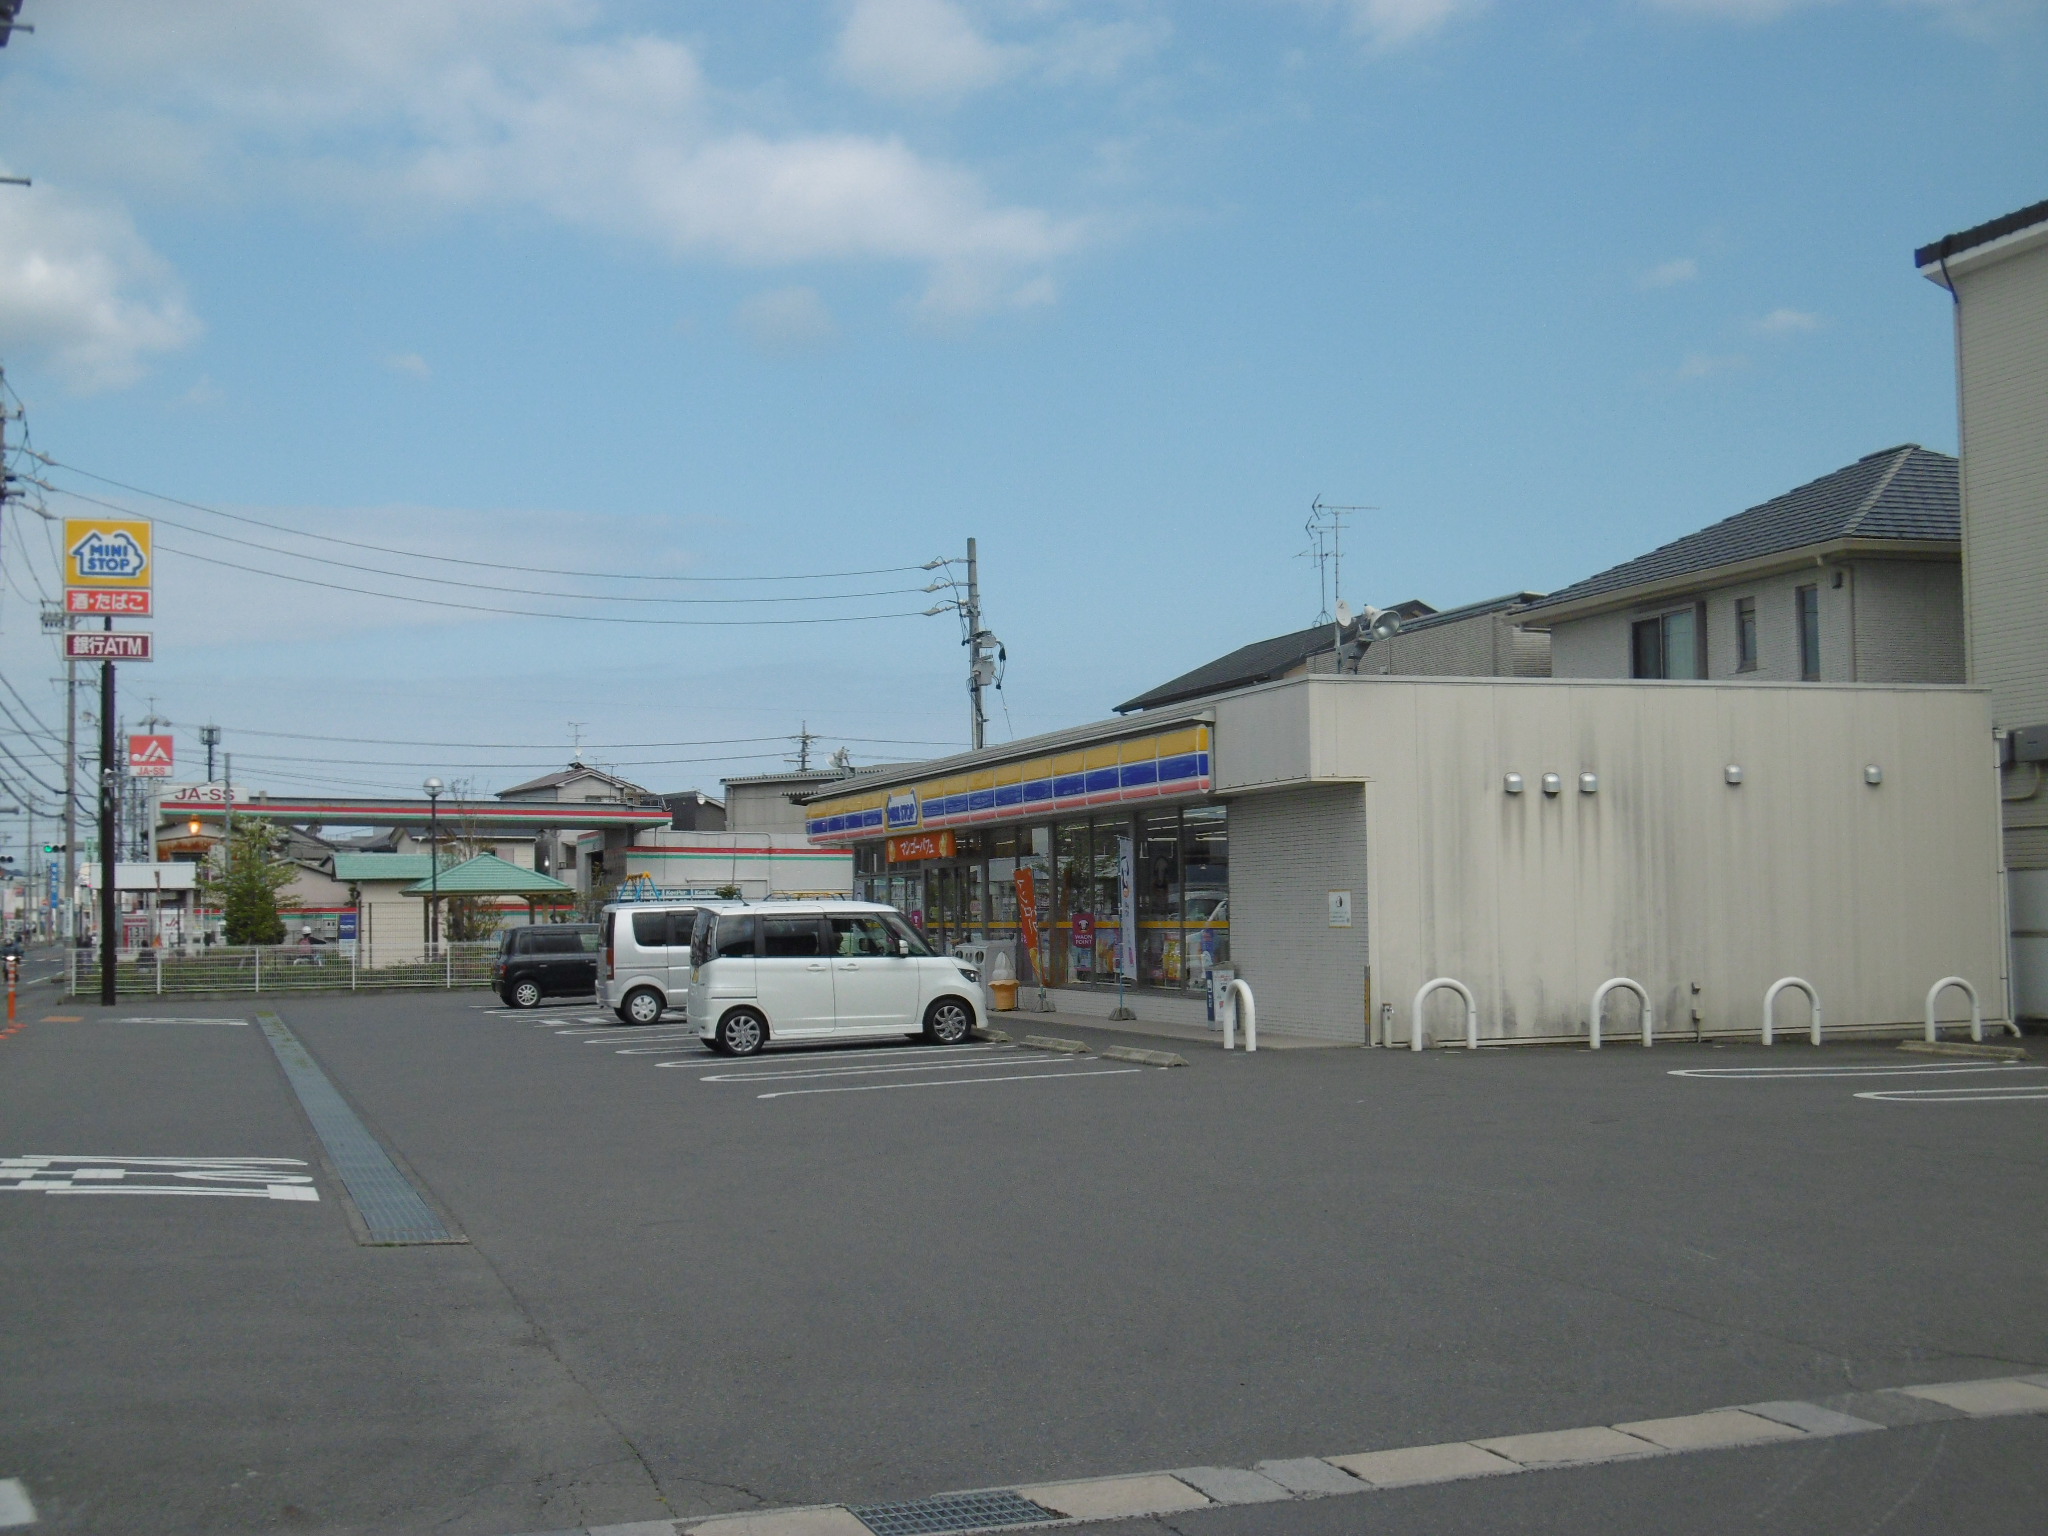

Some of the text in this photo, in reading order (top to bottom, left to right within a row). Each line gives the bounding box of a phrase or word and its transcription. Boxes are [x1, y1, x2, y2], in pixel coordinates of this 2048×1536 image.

[89, 544, 128, 557] MINI
[88, 558, 130, 571] STOP
[73, 636, 142, 655] 銀行ATM
[137, 767, 165, 775] JA-SS
[175, 788, 235, 801] JA-SS
[900, 837, 935, 856] マンゴーパフェ
